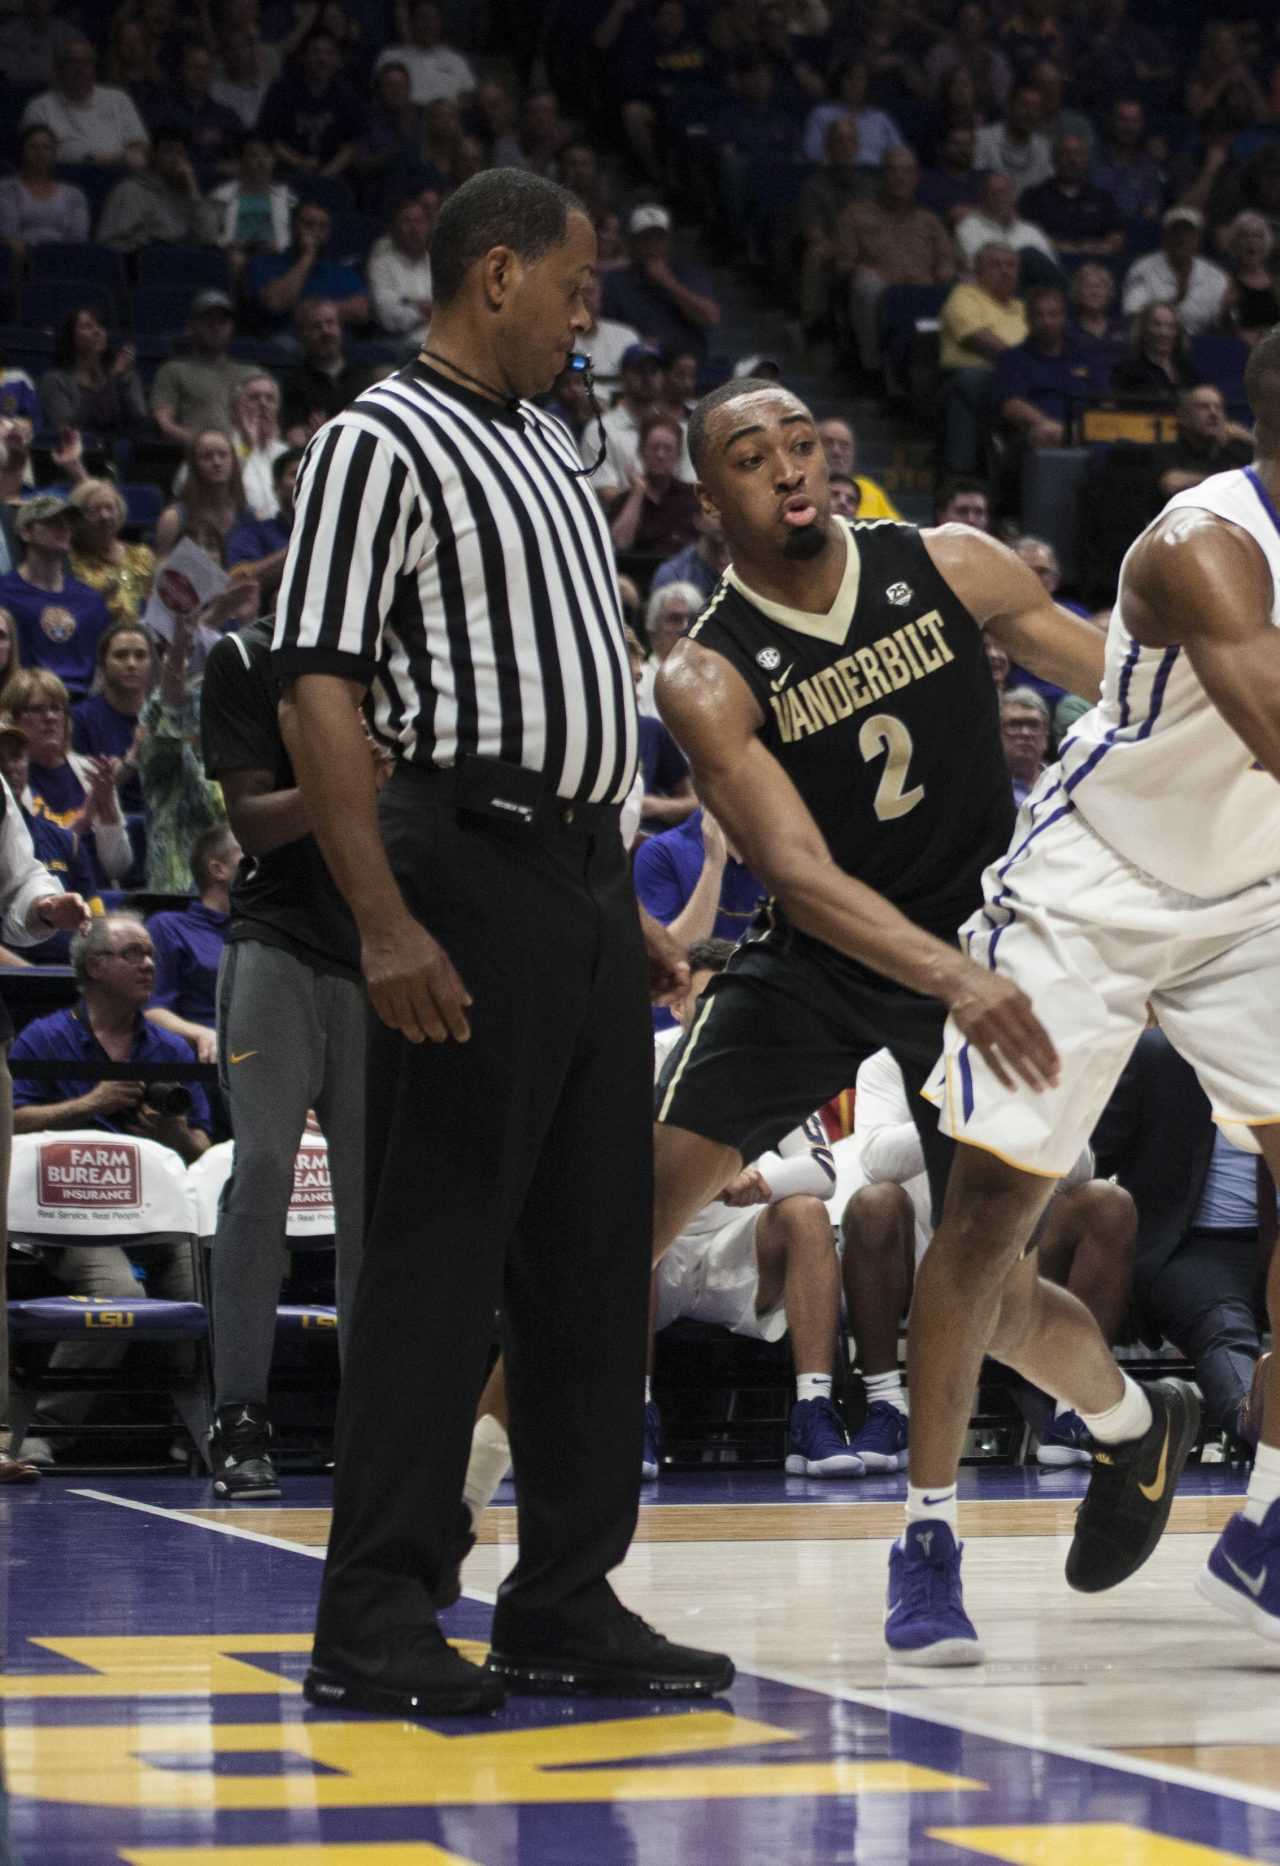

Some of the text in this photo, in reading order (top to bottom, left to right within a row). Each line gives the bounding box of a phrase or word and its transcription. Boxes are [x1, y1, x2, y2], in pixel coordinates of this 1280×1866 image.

[768, 608, 955, 744] VANDERBILT
[859, 714, 925, 822] 2
[71, 1149, 129, 1166] FARM
[47, 1166, 132, 1184] BUREAU
[294, 1170, 332, 1187] EAU
[62, 1188, 132, 1200] INSURANCE
[85, 1312, 134, 1328] LSU
[302, 1315, 337, 1329] LS
